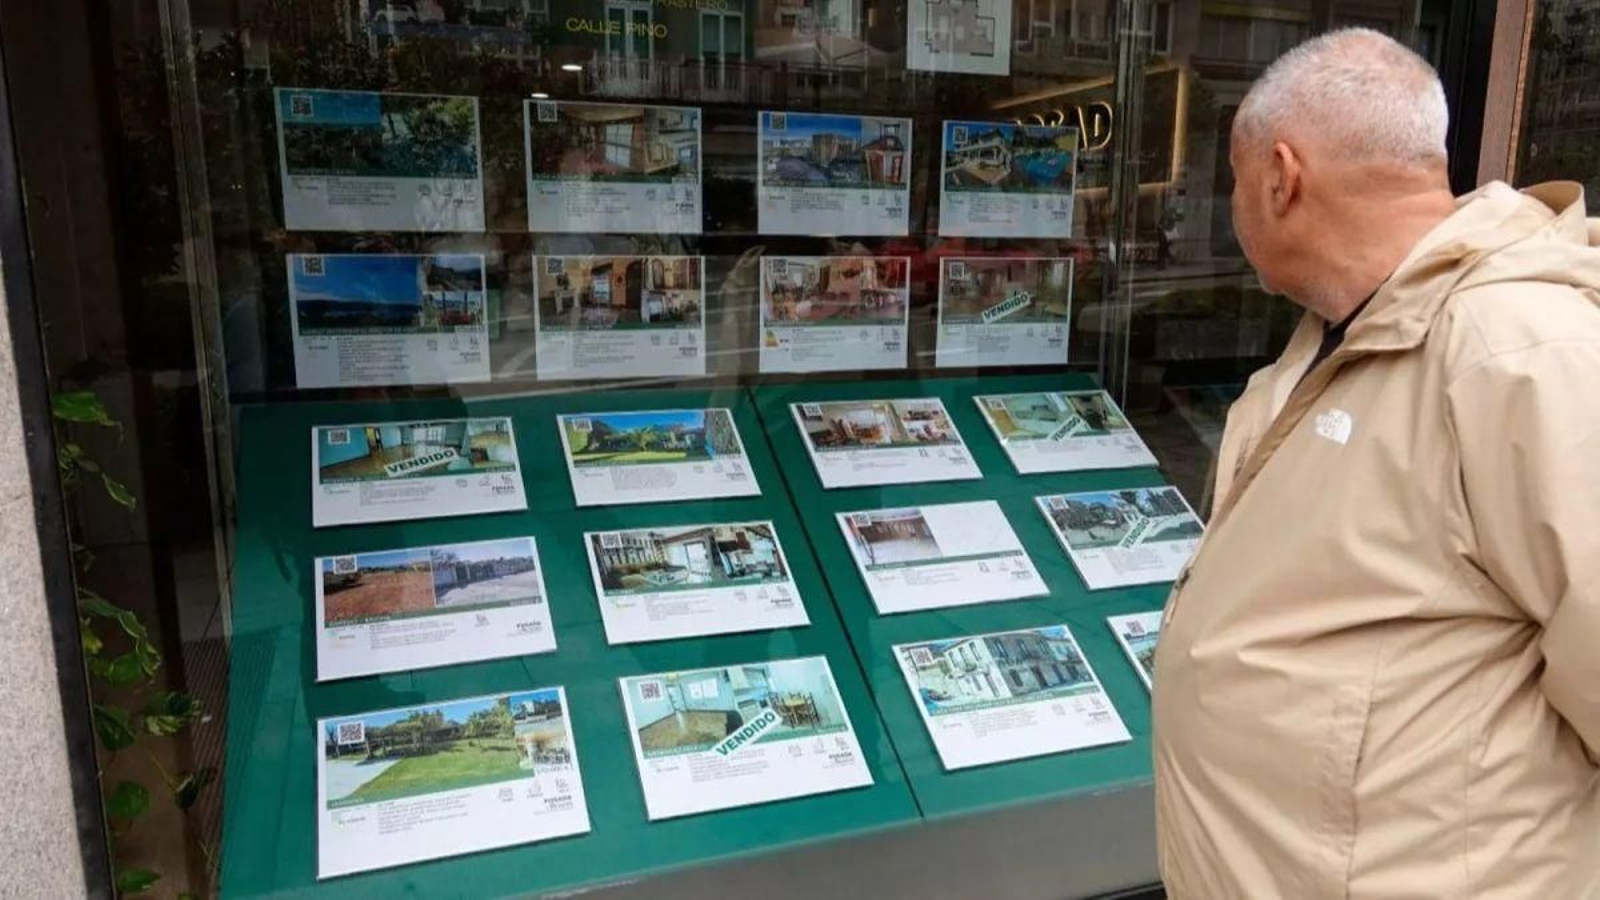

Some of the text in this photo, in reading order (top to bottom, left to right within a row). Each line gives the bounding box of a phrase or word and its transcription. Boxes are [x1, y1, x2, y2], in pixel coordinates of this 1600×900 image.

[565, 17, 668, 38] CALLE PINO
[983, 294, 1028, 319] VENDIDO
[388, 451, 455, 474] VENDIDO
[717, 711, 775, 757] VENDIDO
